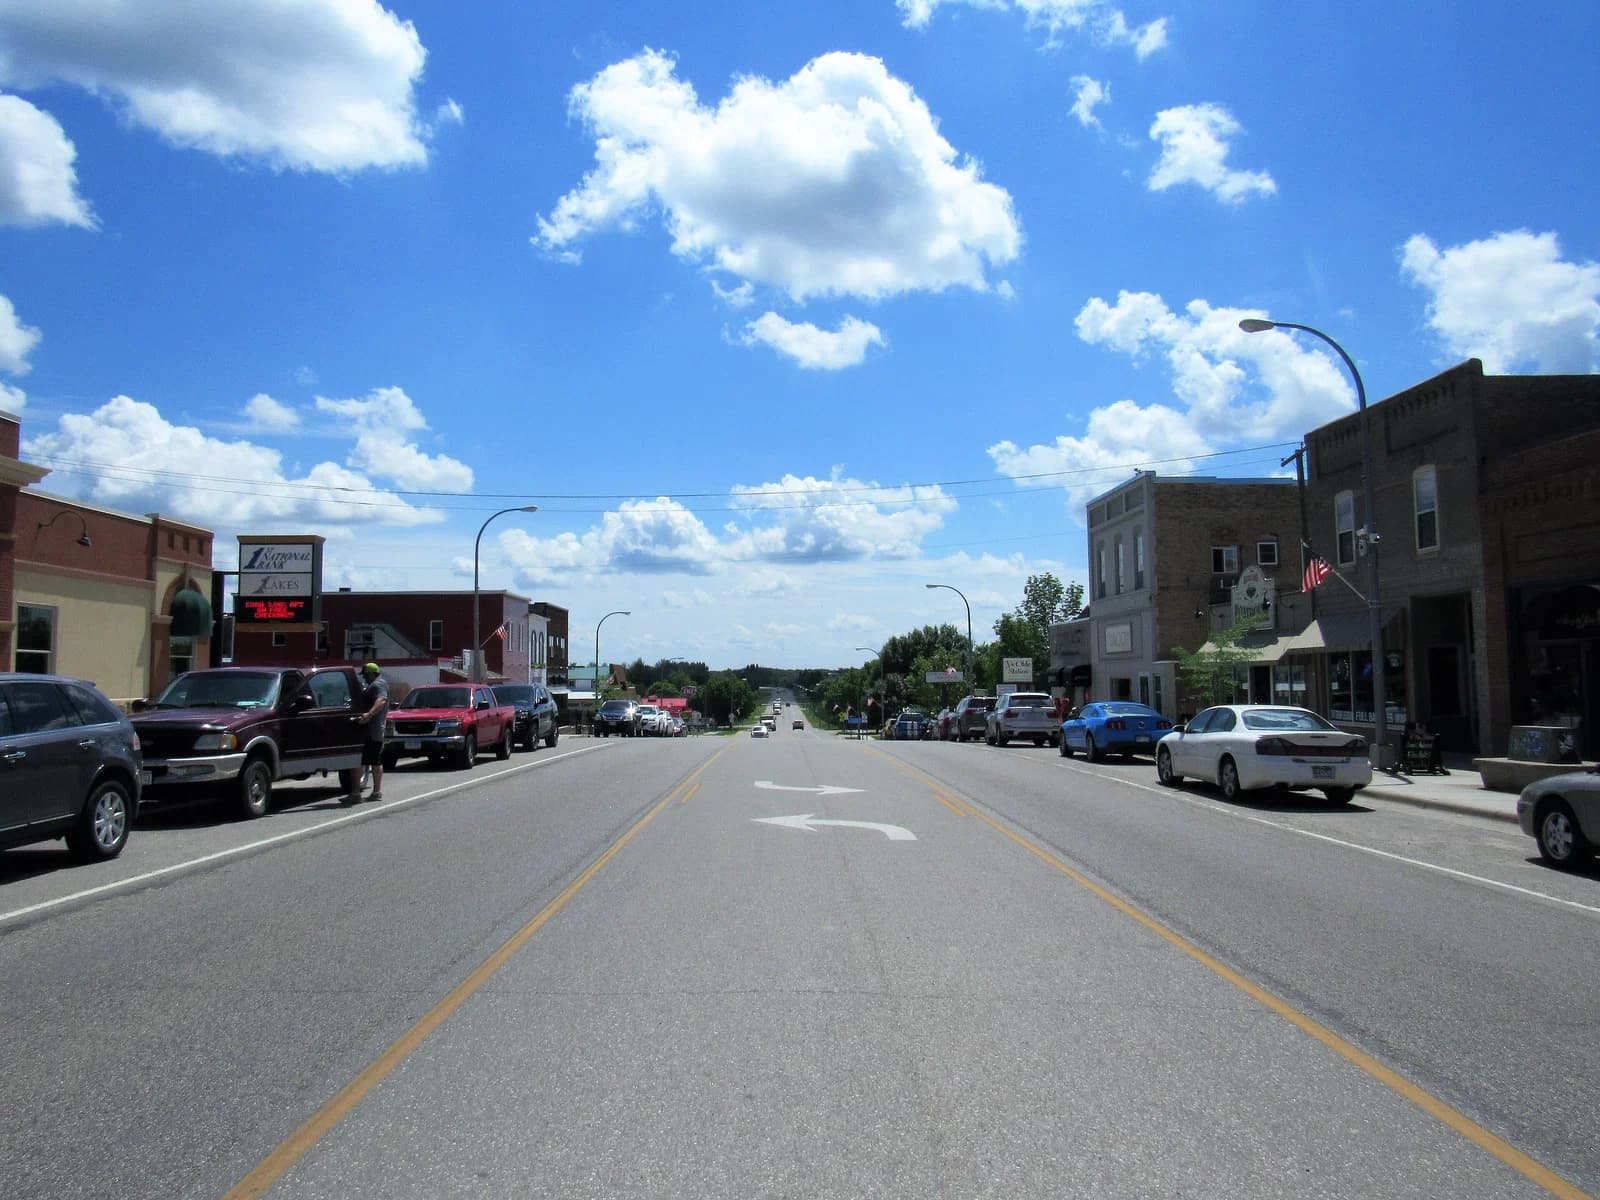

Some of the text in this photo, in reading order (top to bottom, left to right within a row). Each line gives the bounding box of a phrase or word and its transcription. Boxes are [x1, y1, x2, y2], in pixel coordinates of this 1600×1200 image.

[263, 552, 311, 561] NATIONAL
[256, 560, 288, 569] BANK
[1355, 711, 1369, 722] FULL
